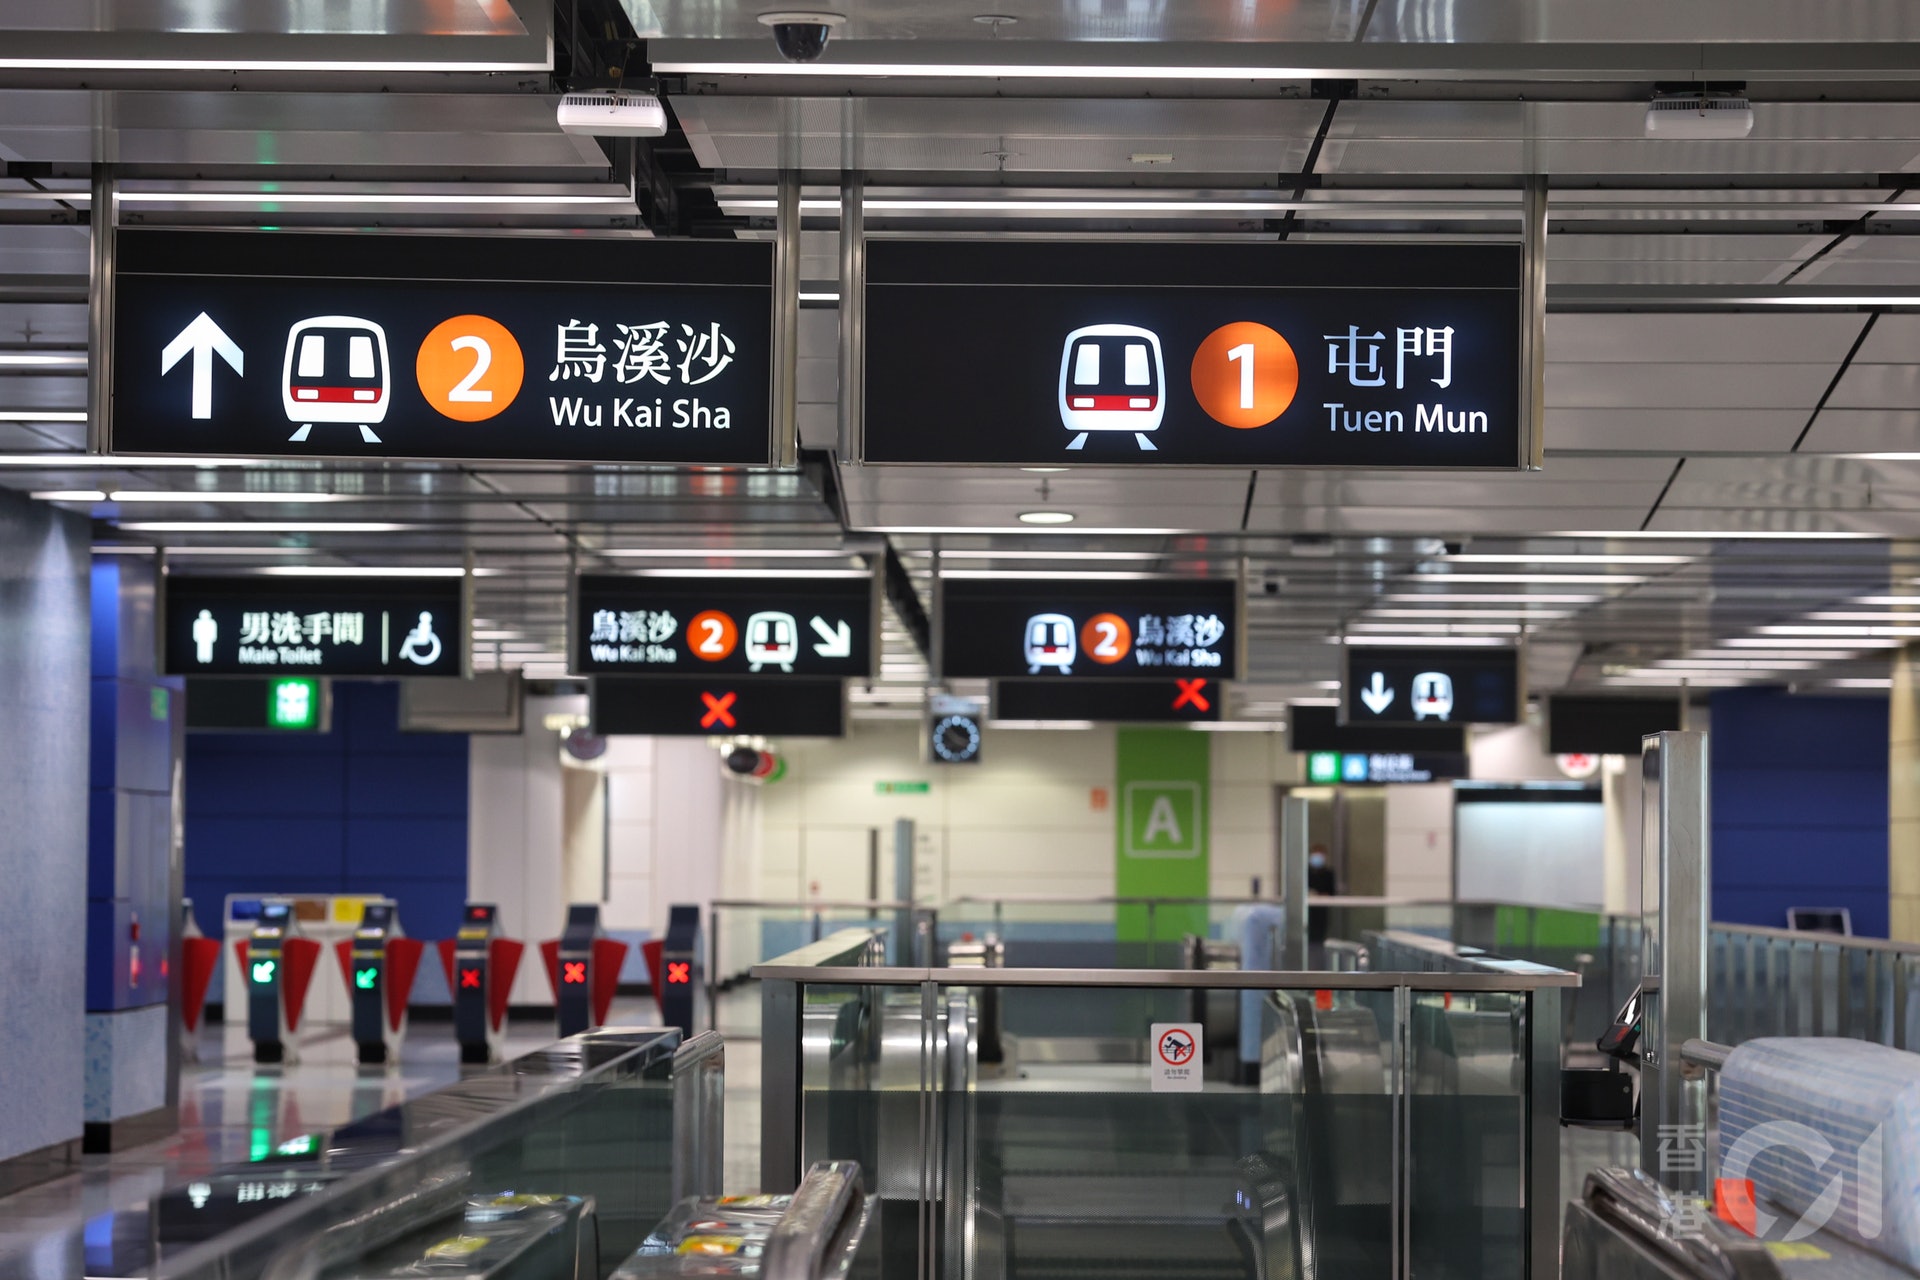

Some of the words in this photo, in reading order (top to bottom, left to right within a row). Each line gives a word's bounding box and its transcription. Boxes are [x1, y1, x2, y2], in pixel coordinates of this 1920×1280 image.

[448, 335, 493, 403] 2
[549, 318, 736, 386] 烏溪沙
[1323, 325, 1455, 390] 屯門
[1227, 343, 1256, 410] 1
[549, 396, 602, 427] Wu
[613, 397, 662, 428] Kai
[672, 398, 731, 429] Sha
[1323, 403, 1404, 432] Tuen
[1414, 403, 1488, 433] Mun
[240, 611, 364, 645] 男洗手間
[590, 609, 678, 643] 烏溪沙
[699, 618, 724, 653] 2
[1093, 621, 1119, 656] 2
[1135, 614, 1225, 647] 烏溪沙
[238, 646, 278, 664] Male
[278, 646, 322, 664] Toilet
[590, 644, 619, 662] Wu
[620, 644, 646, 662] Kai
[646, 644, 677, 662] Sha
[1135, 648, 1163, 666] Wu
[1164, 648, 1190, 666] Kai
[1190, 648, 1221, 667] Sha
[1142, 795, 1183, 844] A
